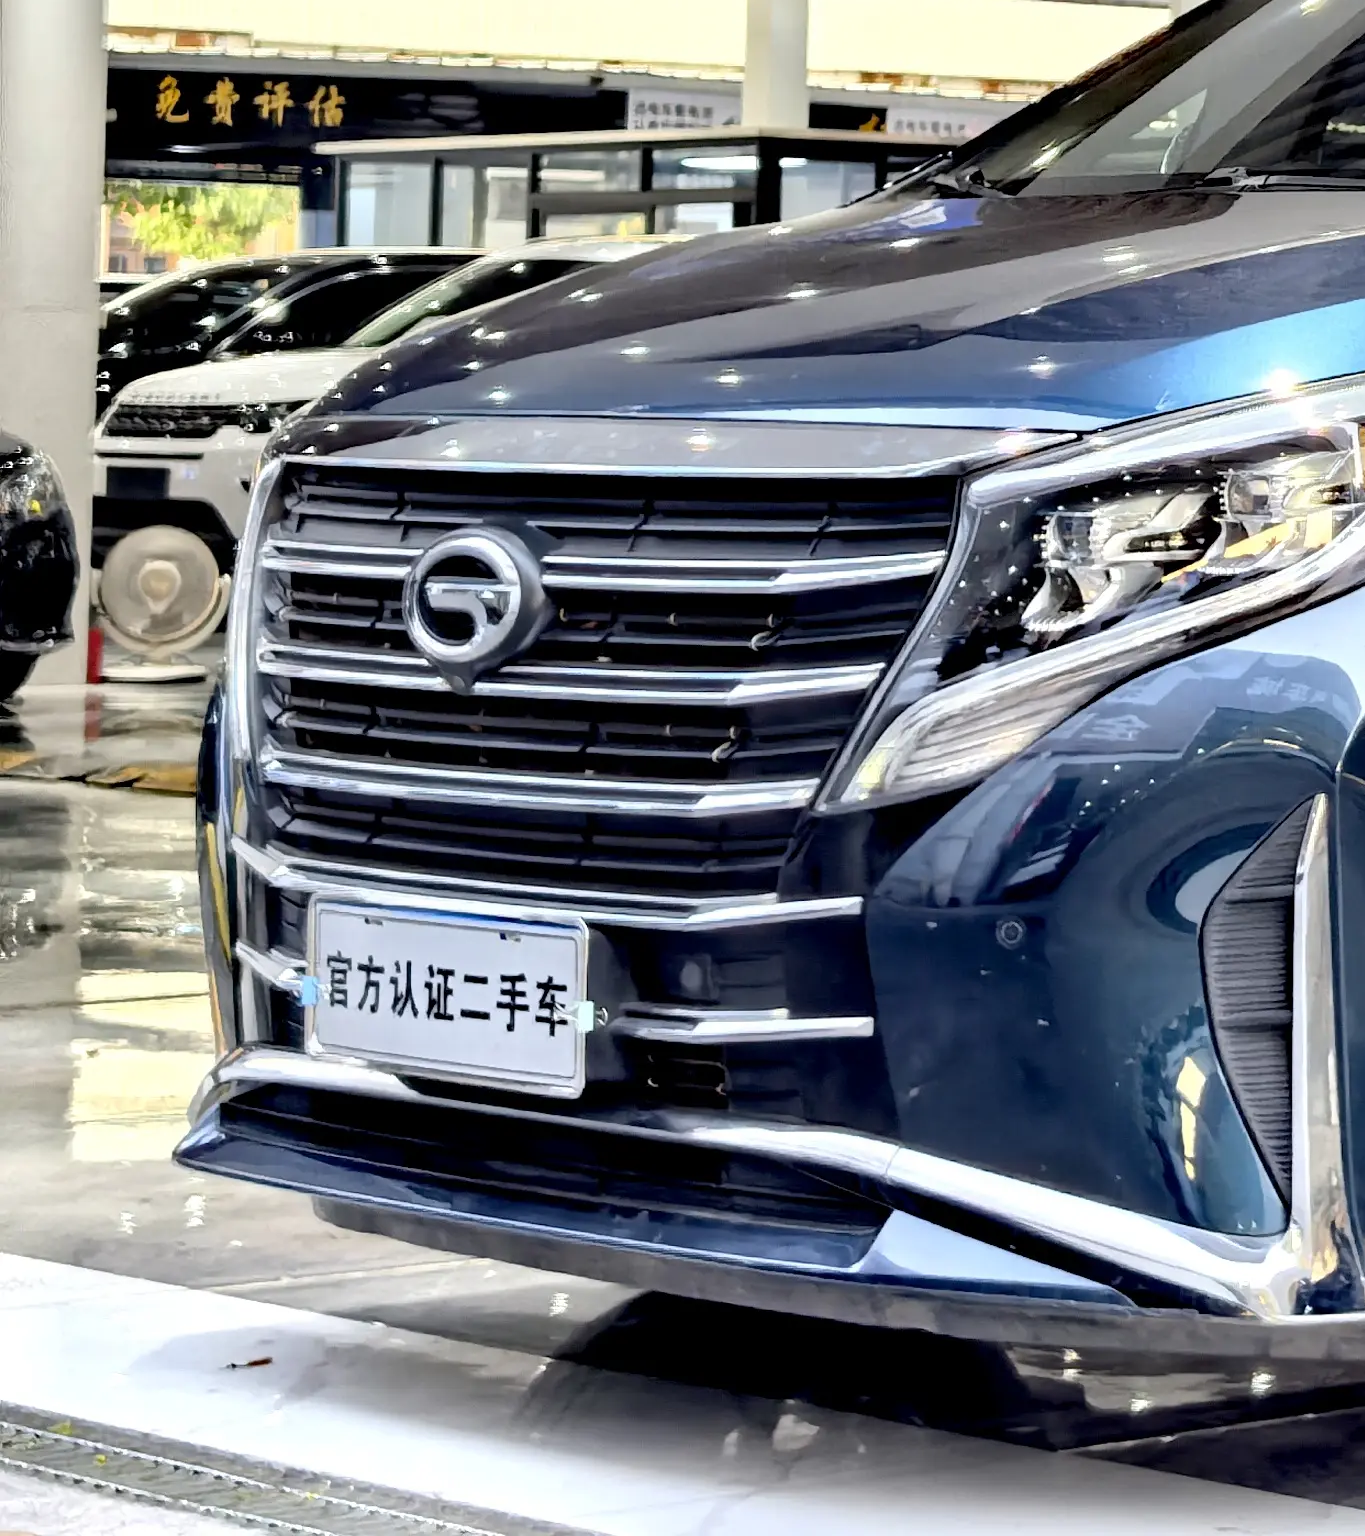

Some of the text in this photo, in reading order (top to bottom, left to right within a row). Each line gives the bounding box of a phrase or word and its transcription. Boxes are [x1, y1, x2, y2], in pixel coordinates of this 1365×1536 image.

[155, 74, 347, 128] 免费评估
[326, 950, 569, 1037] 官方认证二手车
